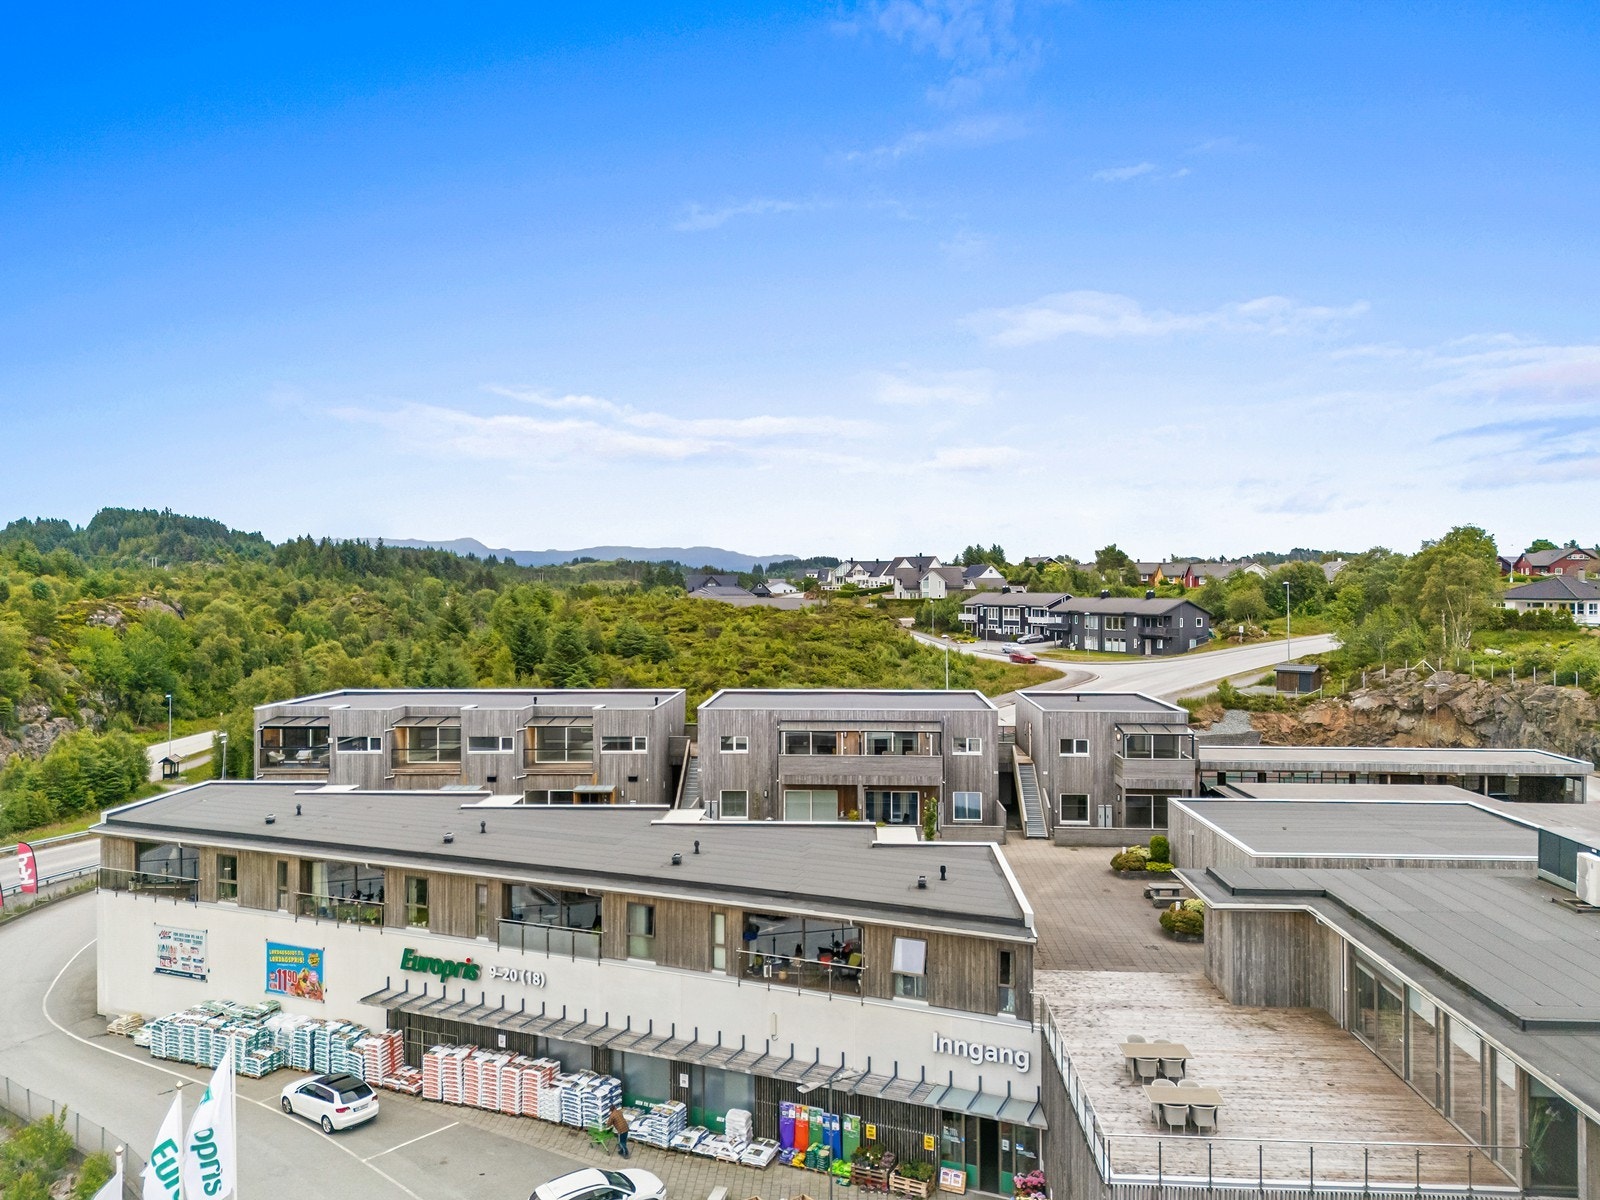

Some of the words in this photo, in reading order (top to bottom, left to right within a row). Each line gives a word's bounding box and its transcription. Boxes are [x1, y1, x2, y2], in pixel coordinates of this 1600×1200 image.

[400, 947, 482, 983] Europris
[521, 968, 546, 989] (18)
[932, 1031, 1031, 1073] Inngang
